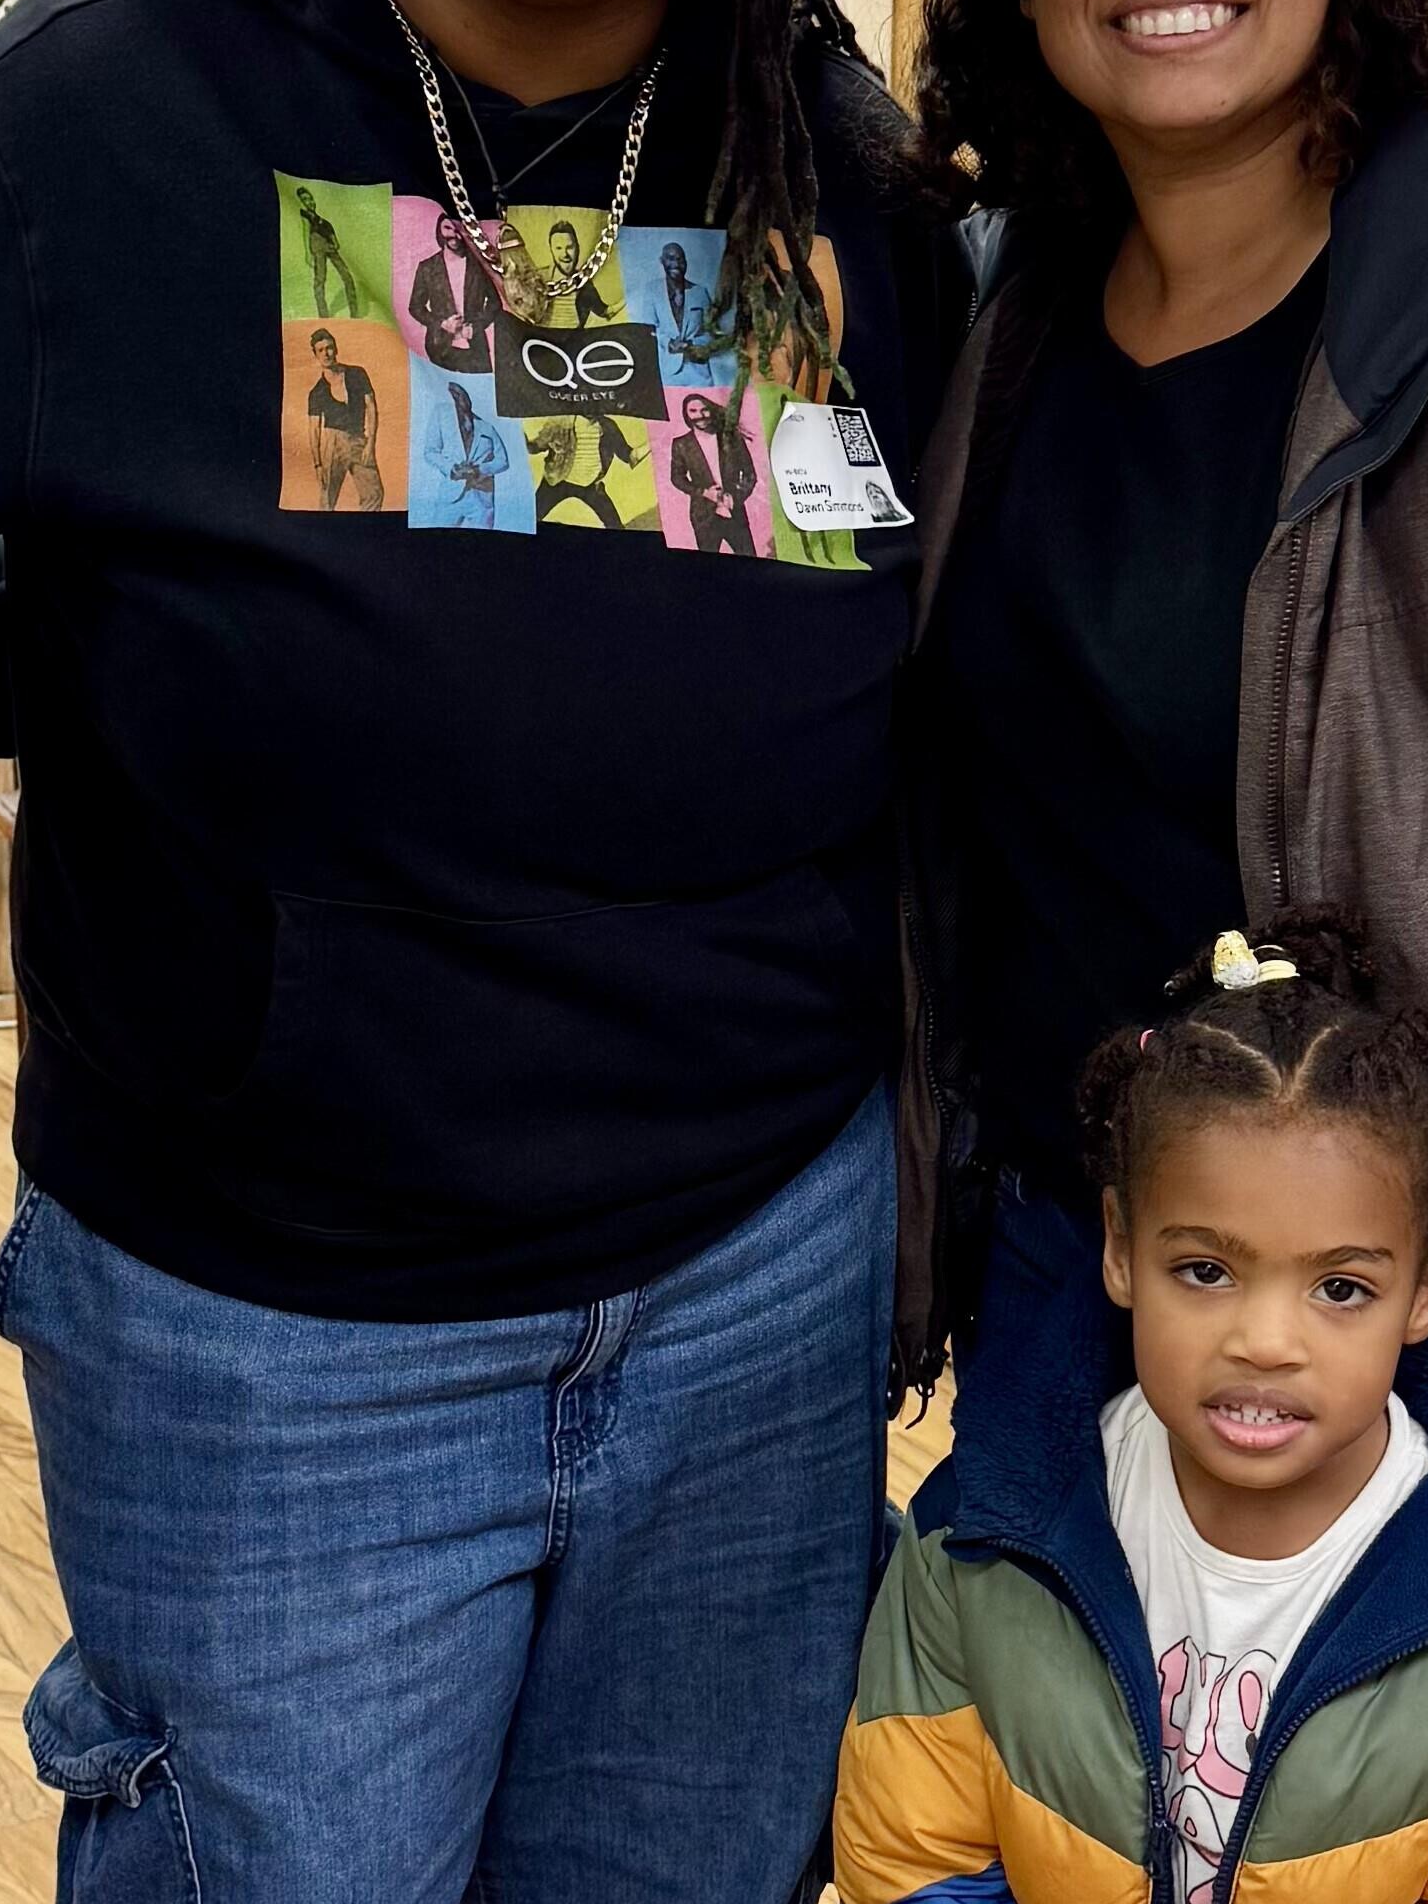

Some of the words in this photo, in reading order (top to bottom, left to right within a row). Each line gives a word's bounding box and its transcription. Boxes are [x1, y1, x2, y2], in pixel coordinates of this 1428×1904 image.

[548, 390, 589, 402] QUEER
[592, 390, 616, 400] EYE
[789, 481, 832, 497] Brittany
[795, 501, 824, 514] Dawn
